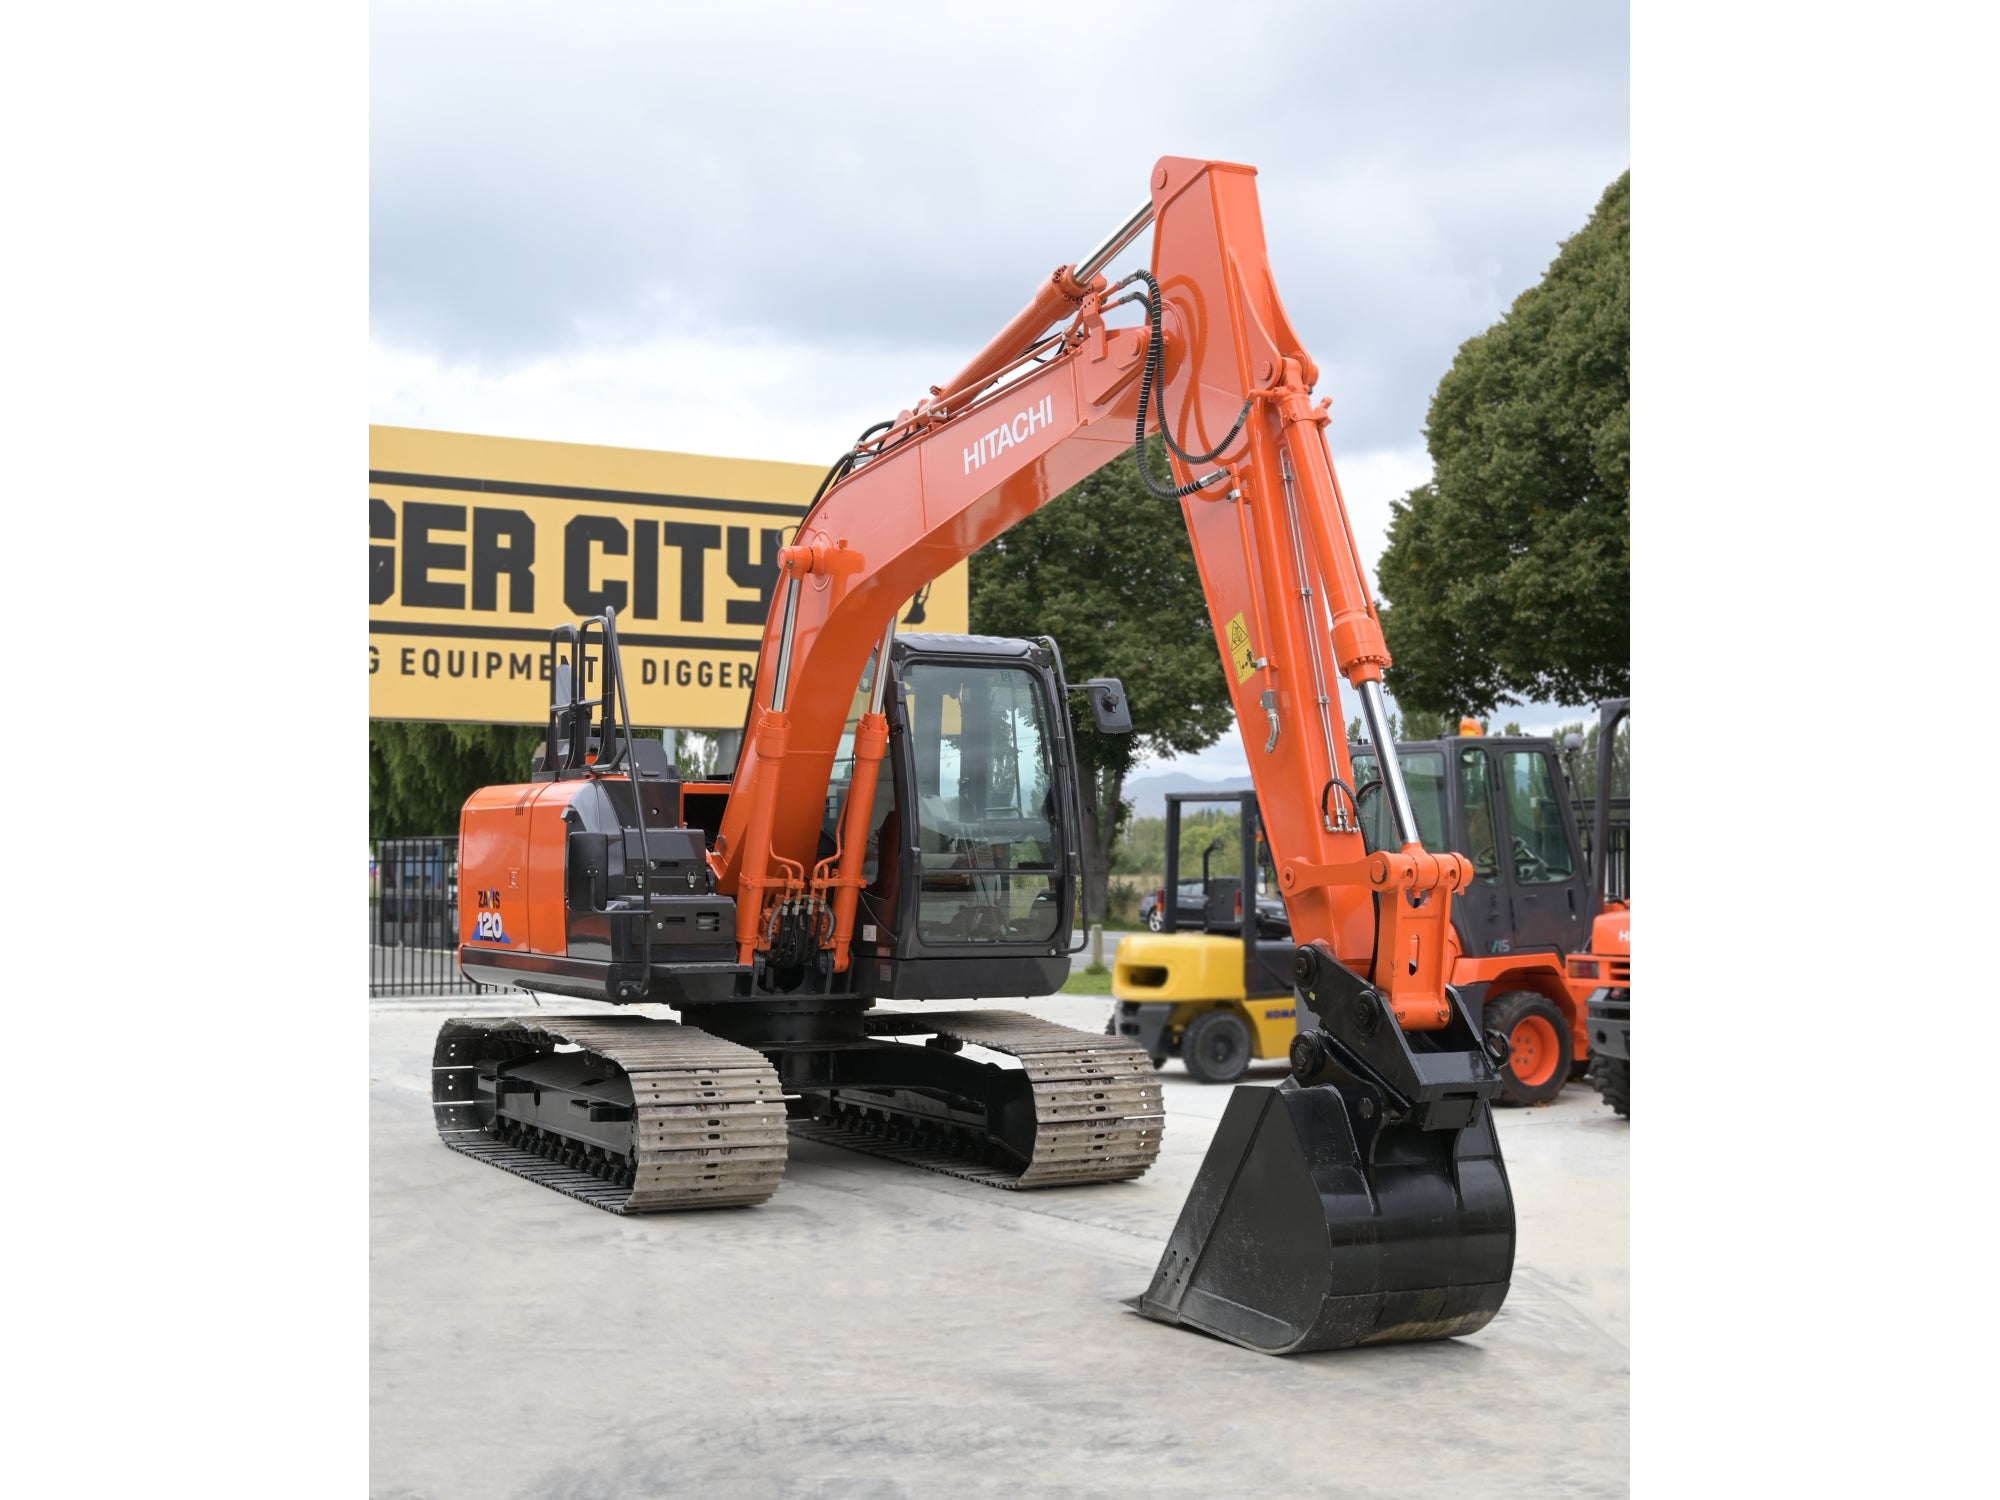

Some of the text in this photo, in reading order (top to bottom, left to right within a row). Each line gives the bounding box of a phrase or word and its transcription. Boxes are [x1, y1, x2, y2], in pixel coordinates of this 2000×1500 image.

[963, 394, 1053, 475] HITACHI
[563, 514, 783, 627] CITY
[401, 647, 598, 683] EQUIPMET
[477, 911, 503, 940] 120
